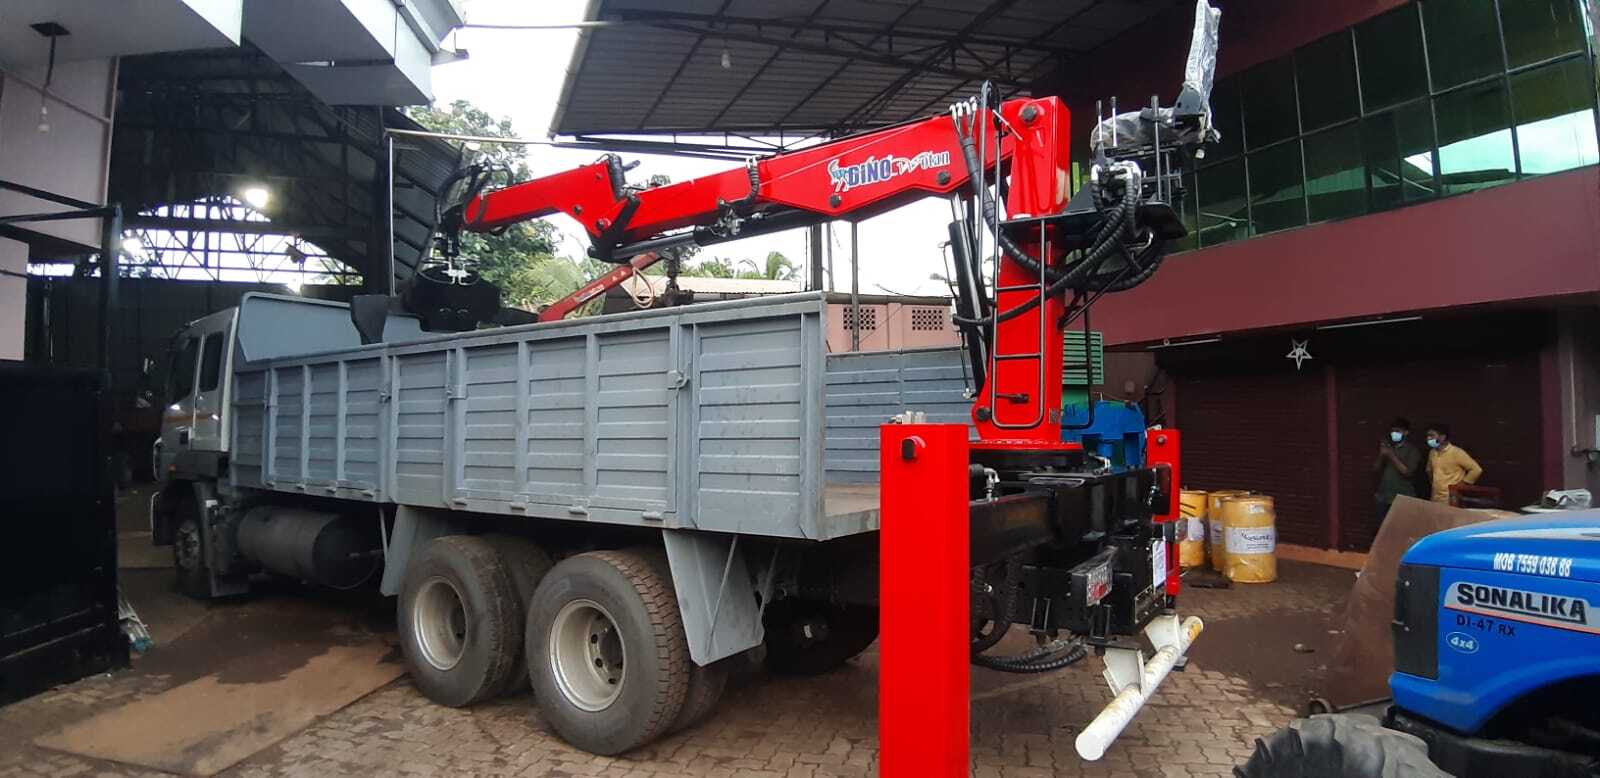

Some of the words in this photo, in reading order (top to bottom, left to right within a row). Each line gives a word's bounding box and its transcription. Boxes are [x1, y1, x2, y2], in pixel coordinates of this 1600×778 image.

[1493, 552, 1515, 571] MOB
[1517, 554, 1539, 574] 7559
[1457, 583, 1587, 623] SONALIKA
[1456, 614, 1494, 631] DI-47
[1498, 624, 1516, 636] RX
[1450, 636, 1474, 650] 4x4
